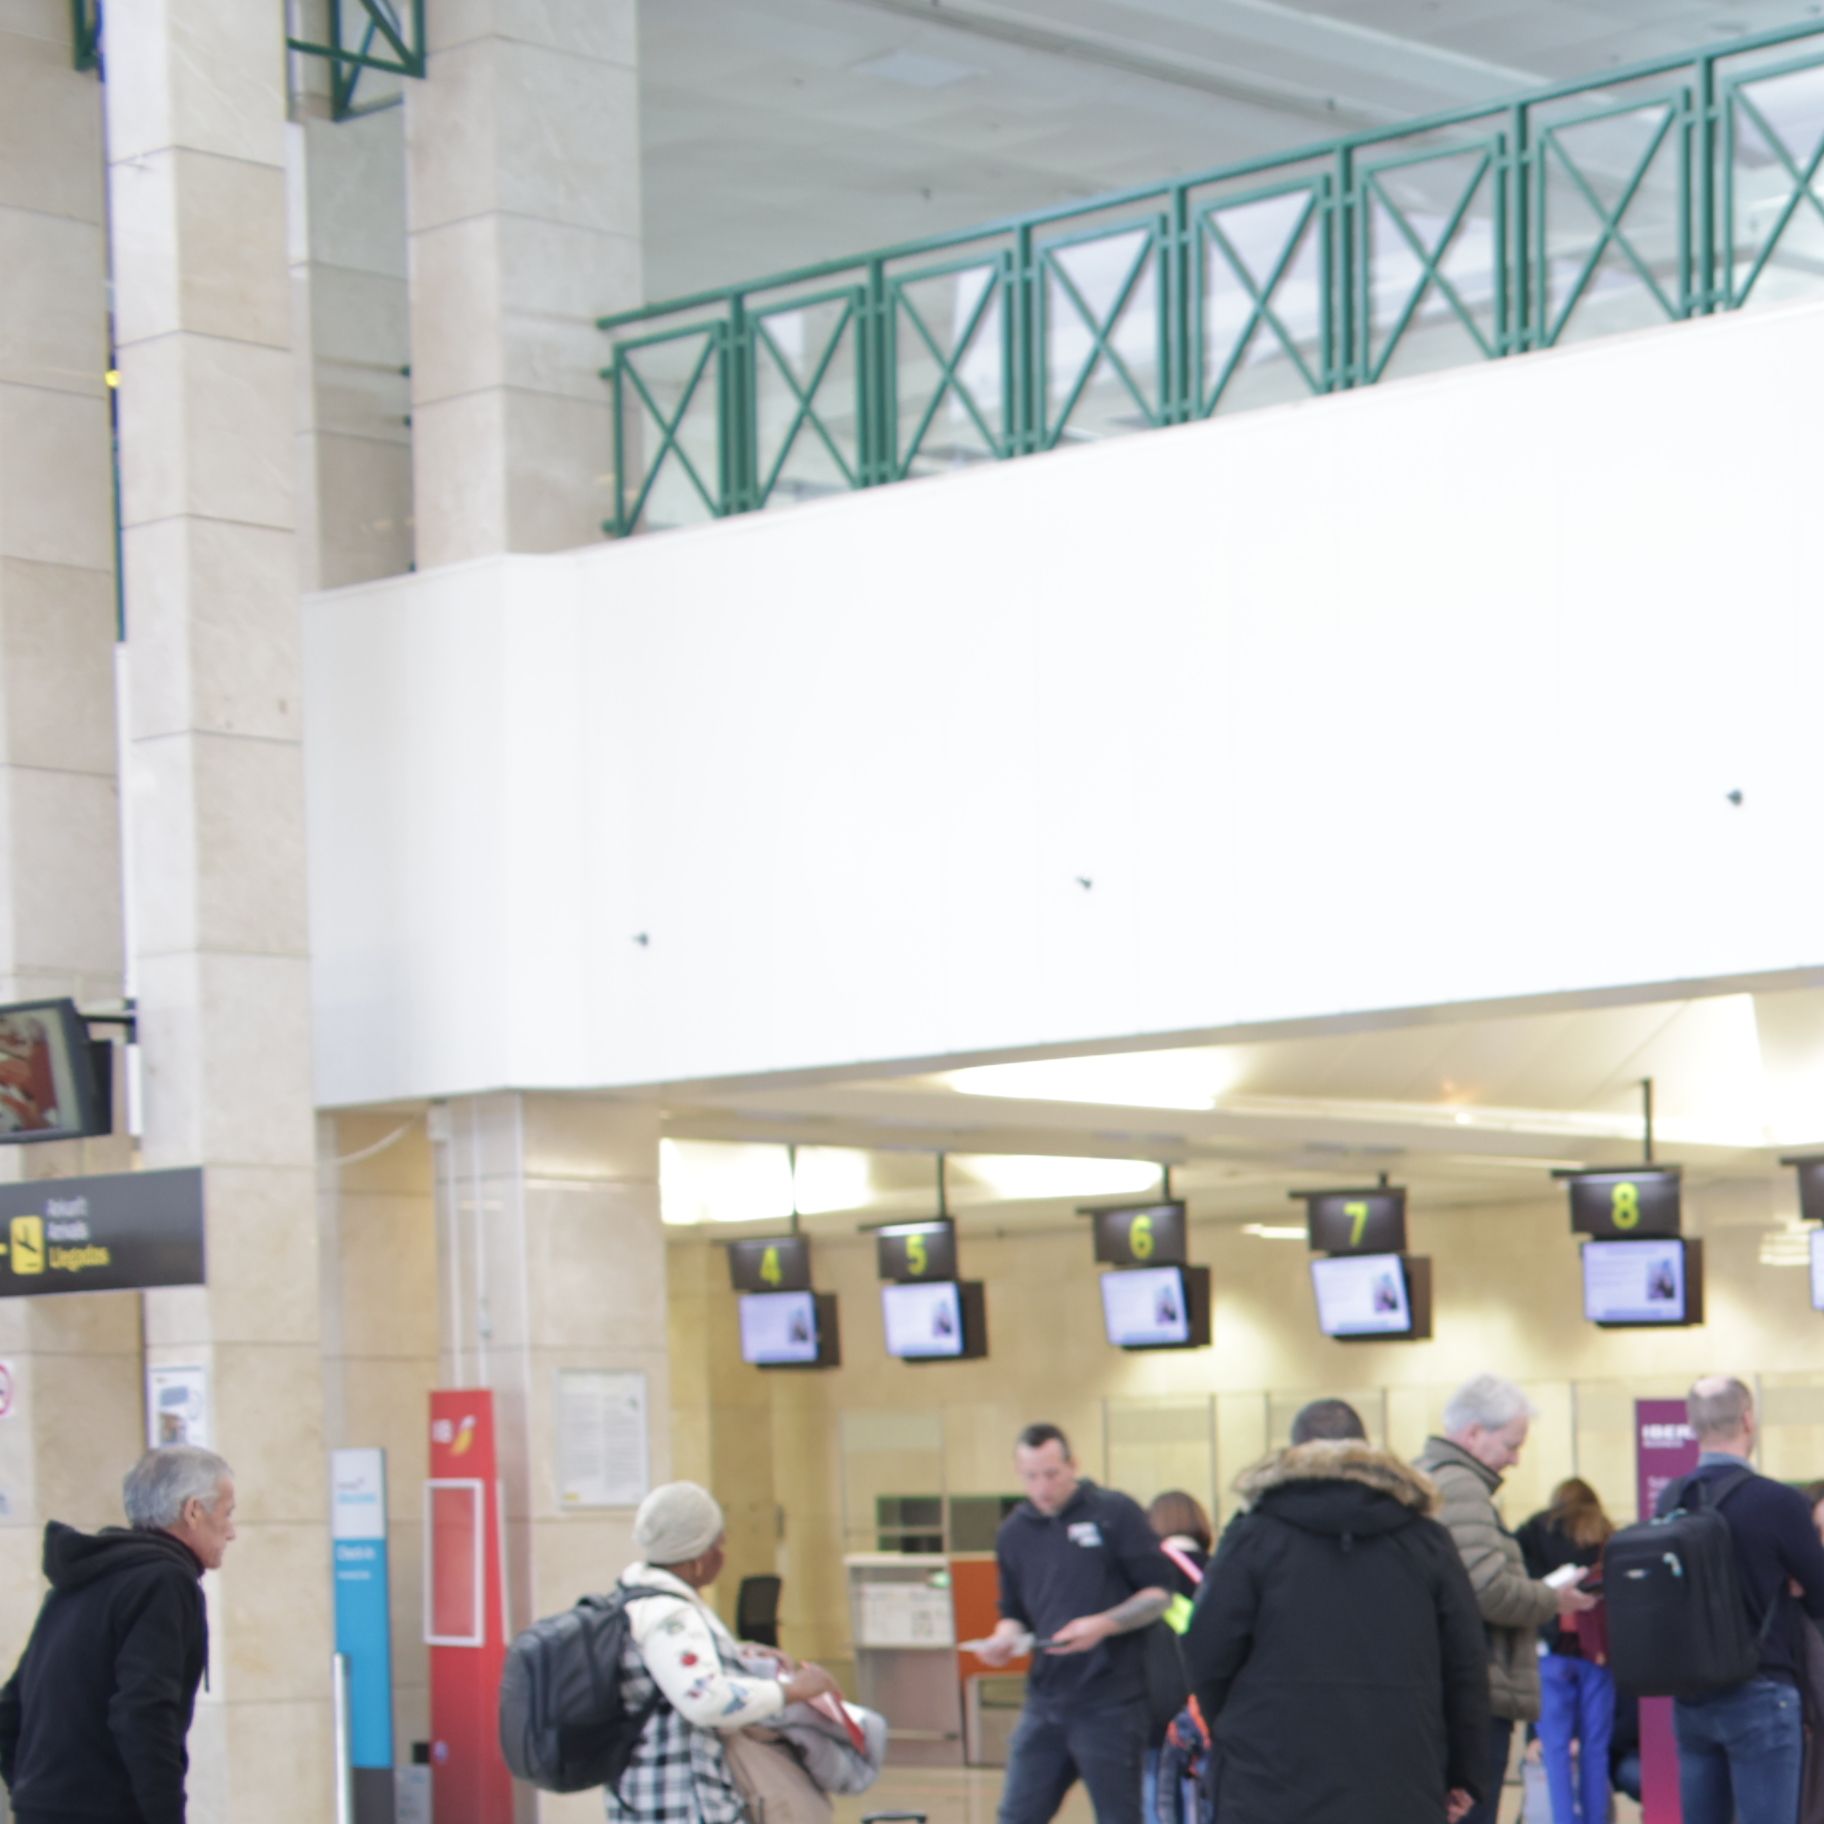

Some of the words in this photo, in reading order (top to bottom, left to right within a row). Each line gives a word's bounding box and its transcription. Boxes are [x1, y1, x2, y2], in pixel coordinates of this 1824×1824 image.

[1342, 1202, 1369, 1247] 7
[1610, 1181, 1640, 1231] 8
[905, 1233, 929, 1277] 5
[1129, 1213, 1155, 1261] 6
[758, 1245, 783, 1287] 4
